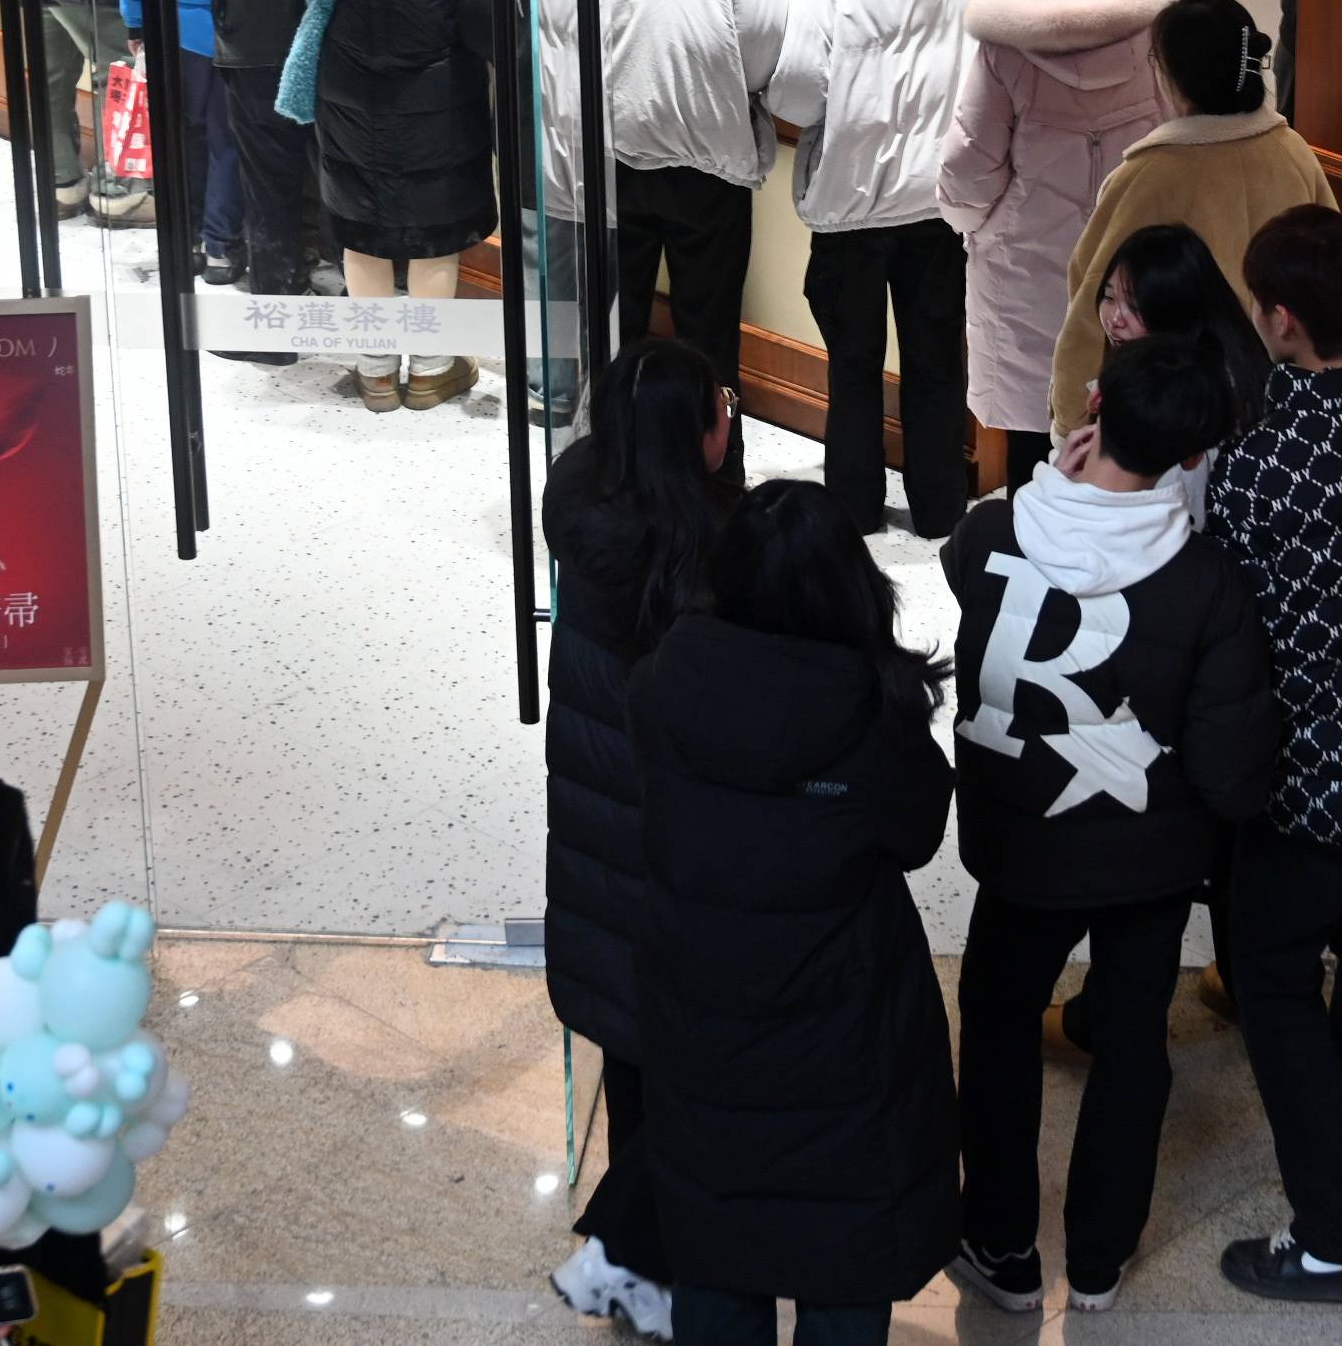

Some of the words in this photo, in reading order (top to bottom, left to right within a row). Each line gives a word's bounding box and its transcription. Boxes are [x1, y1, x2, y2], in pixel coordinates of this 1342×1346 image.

[244, 299, 442, 334] 裕蓮茶樓
[290, 336, 318, 348] CHA
[322, 337, 342, 348] OF
[347, 338, 397, 349] YULIAN
